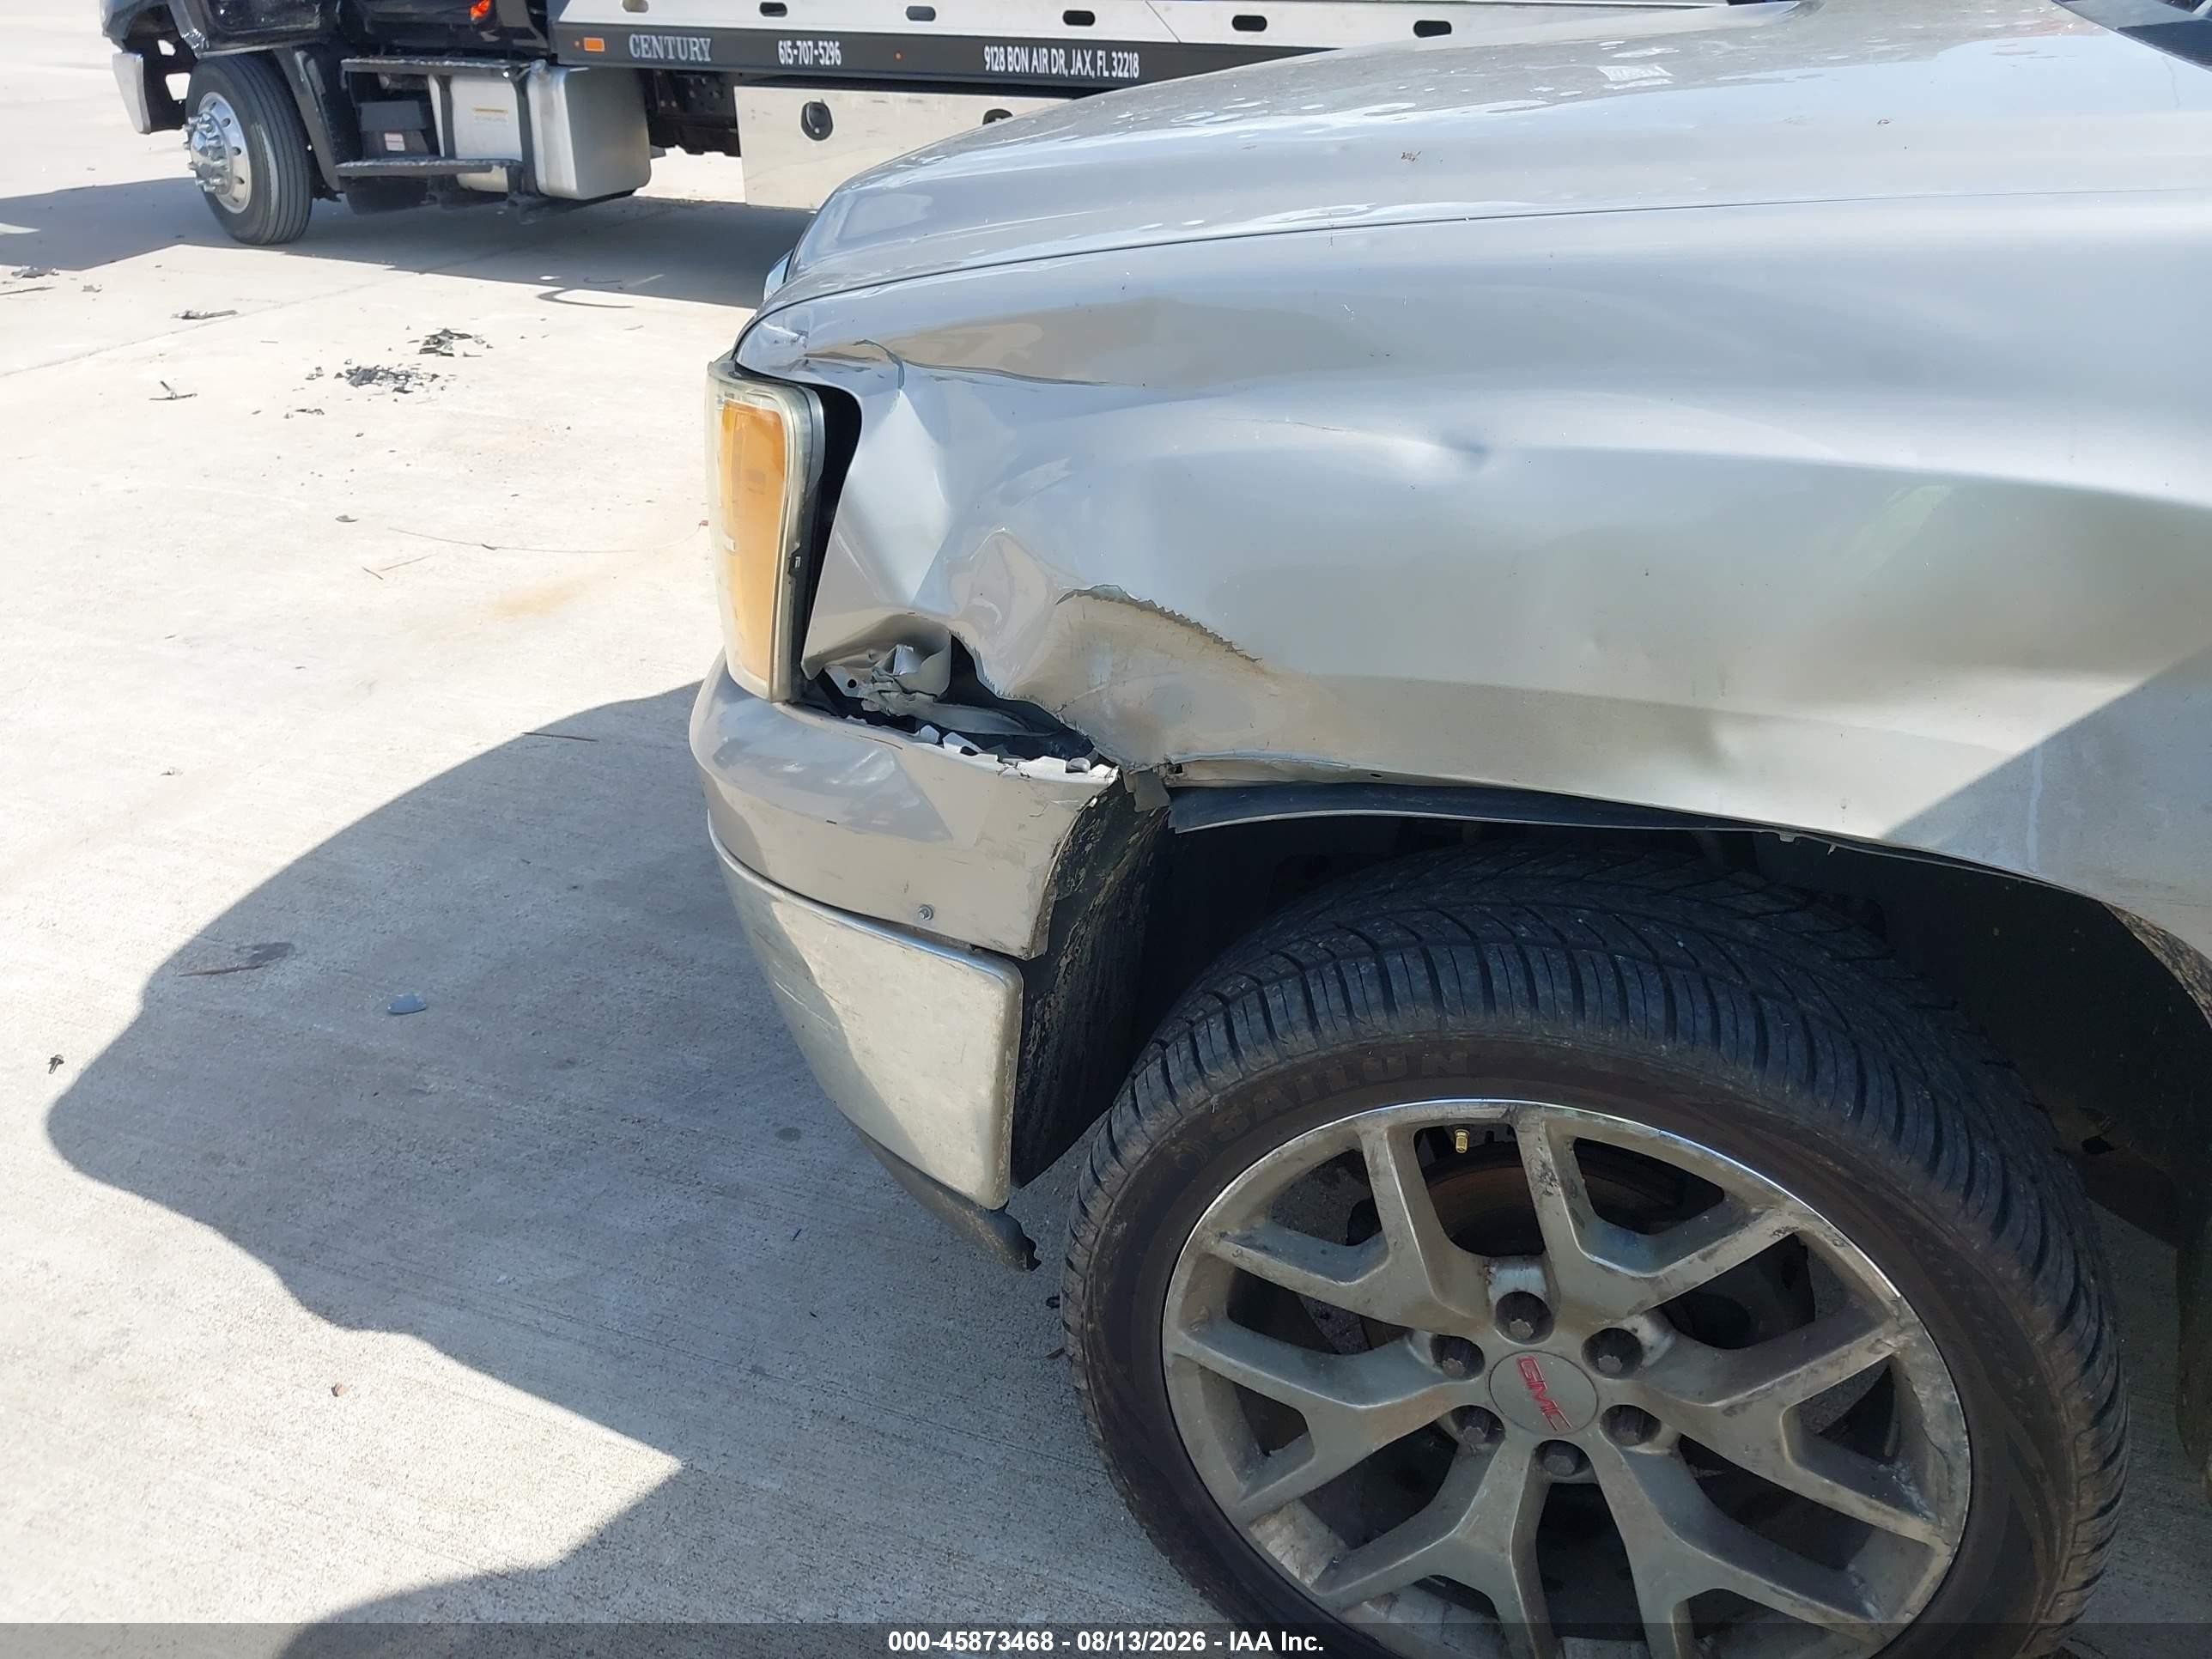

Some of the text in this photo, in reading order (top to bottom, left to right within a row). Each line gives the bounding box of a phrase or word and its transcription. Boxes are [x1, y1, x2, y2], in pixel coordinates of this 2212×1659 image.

[629, 33, 712, 62] CENTURY
[778, 40, 842, 65] 615-707-5296
[983, 45, 1139, 79] 9128 BON AIR DR, JAX, FL 32218
[1516, 1355, 1572, 1431] GMC
